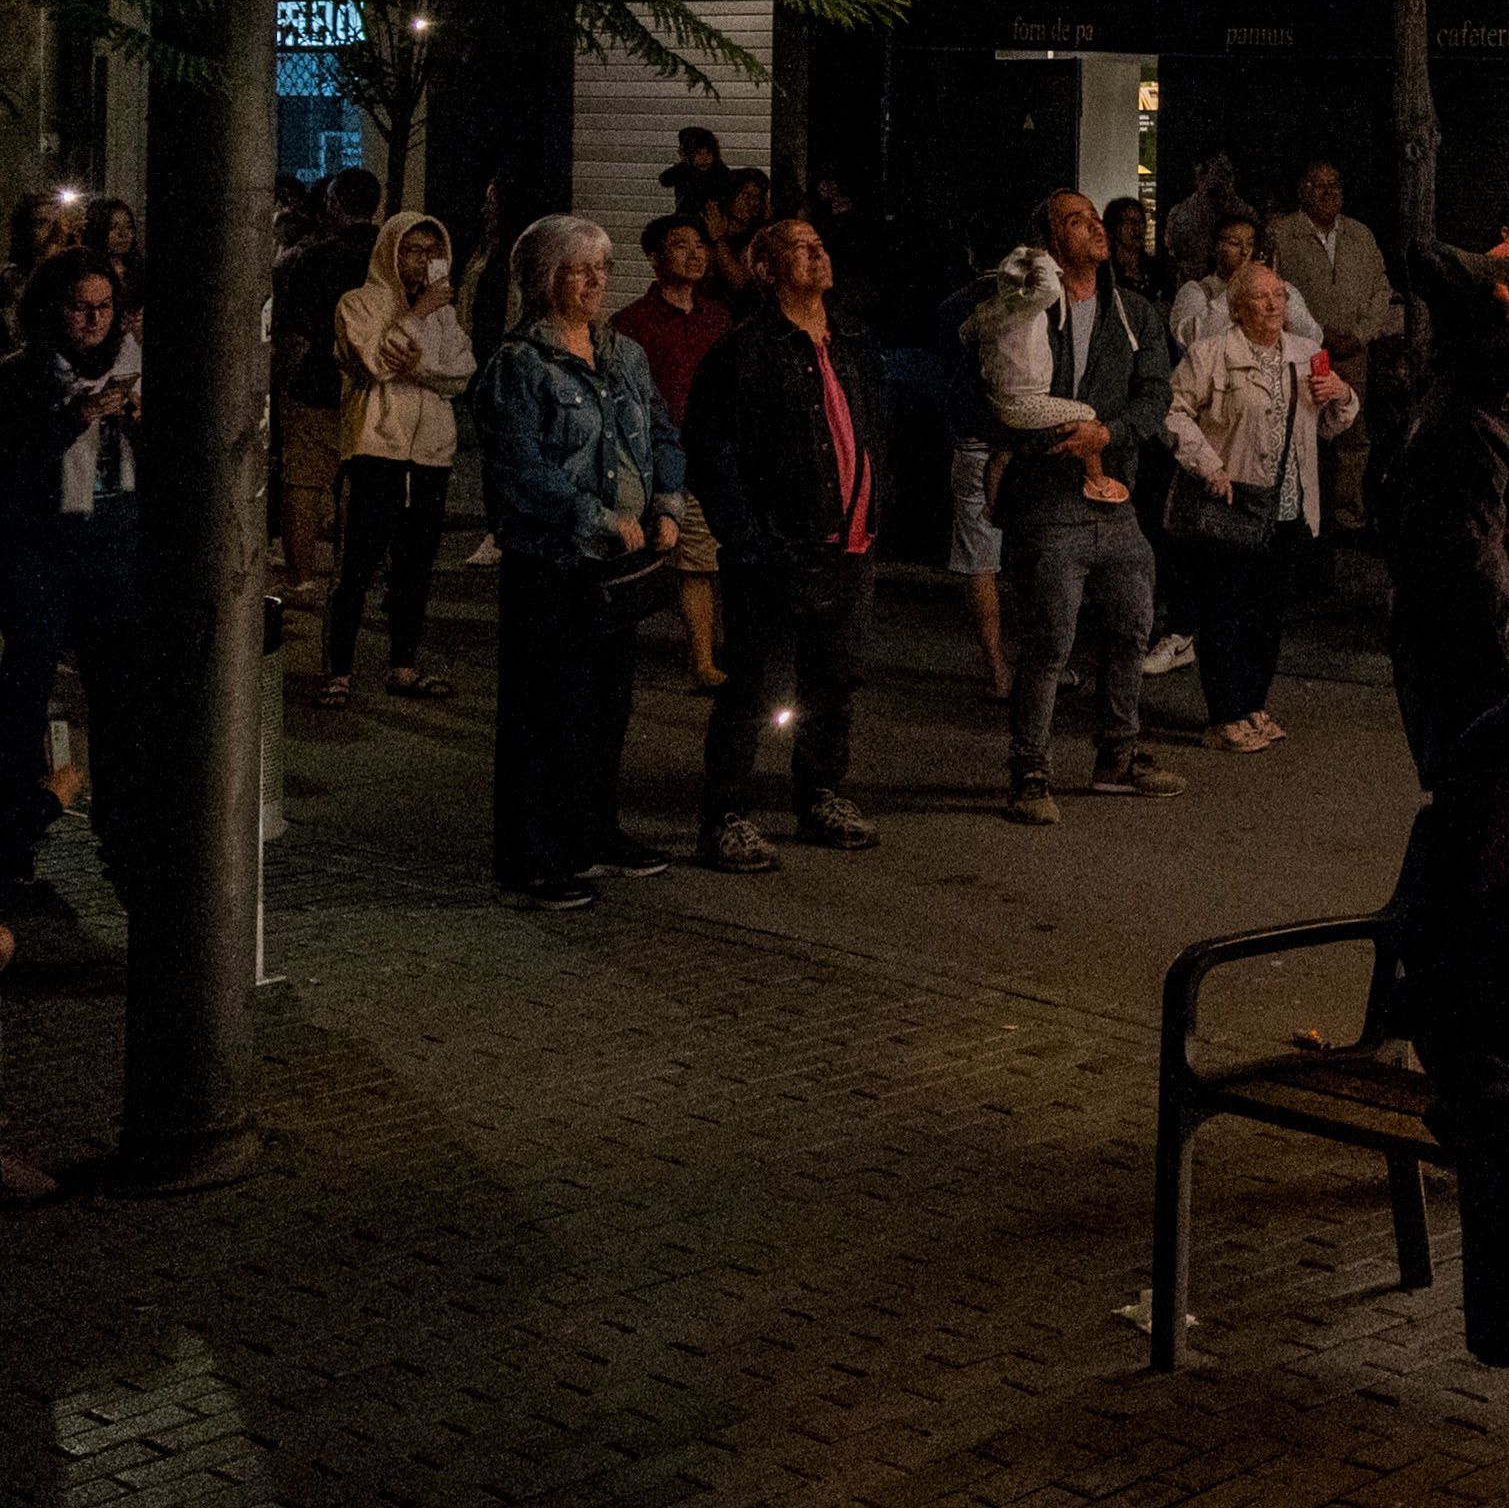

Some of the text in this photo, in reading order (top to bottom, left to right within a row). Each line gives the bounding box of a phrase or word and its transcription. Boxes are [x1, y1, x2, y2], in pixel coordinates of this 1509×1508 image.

[1011, 15, 1095, 48] forn de pa
[1225, 26, 1297, 53] pannus
